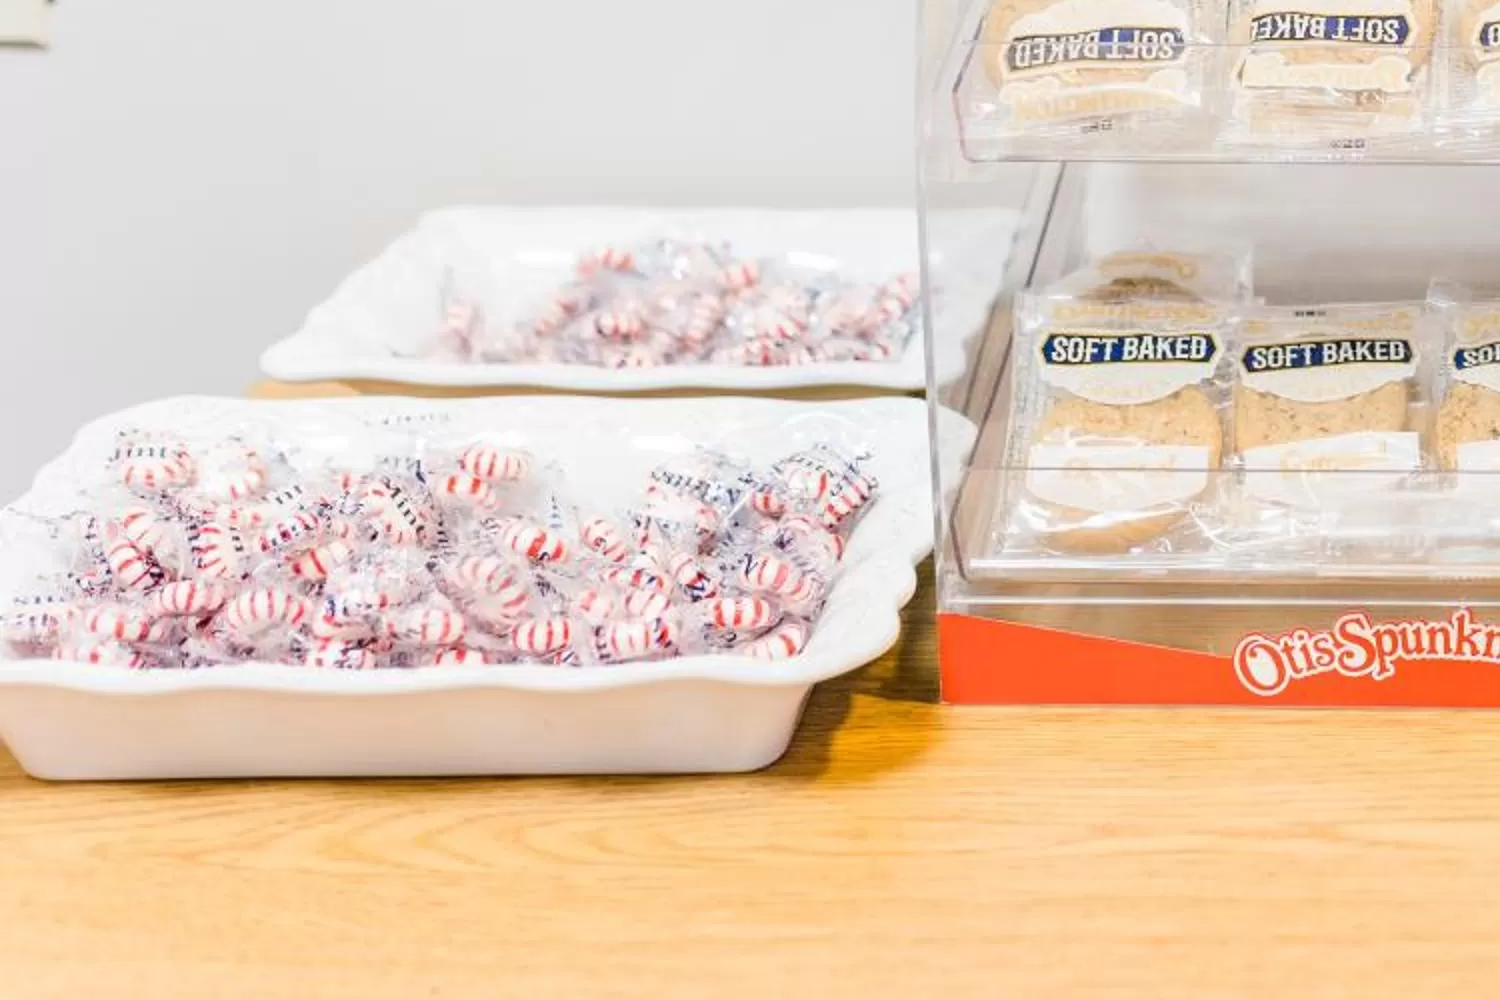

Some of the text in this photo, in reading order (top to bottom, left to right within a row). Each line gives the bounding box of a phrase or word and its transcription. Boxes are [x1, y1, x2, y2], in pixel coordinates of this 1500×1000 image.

[1331, 17, 1400, 43] SOFT
[1014, 29, 1175, 68] SOFT BAKED
[1050, 335, 1208, 363] SOFT BAKED
[1250, 340, 1406, 369] SOFT BAKED
[1234, 628, 1336, 696] Otis
